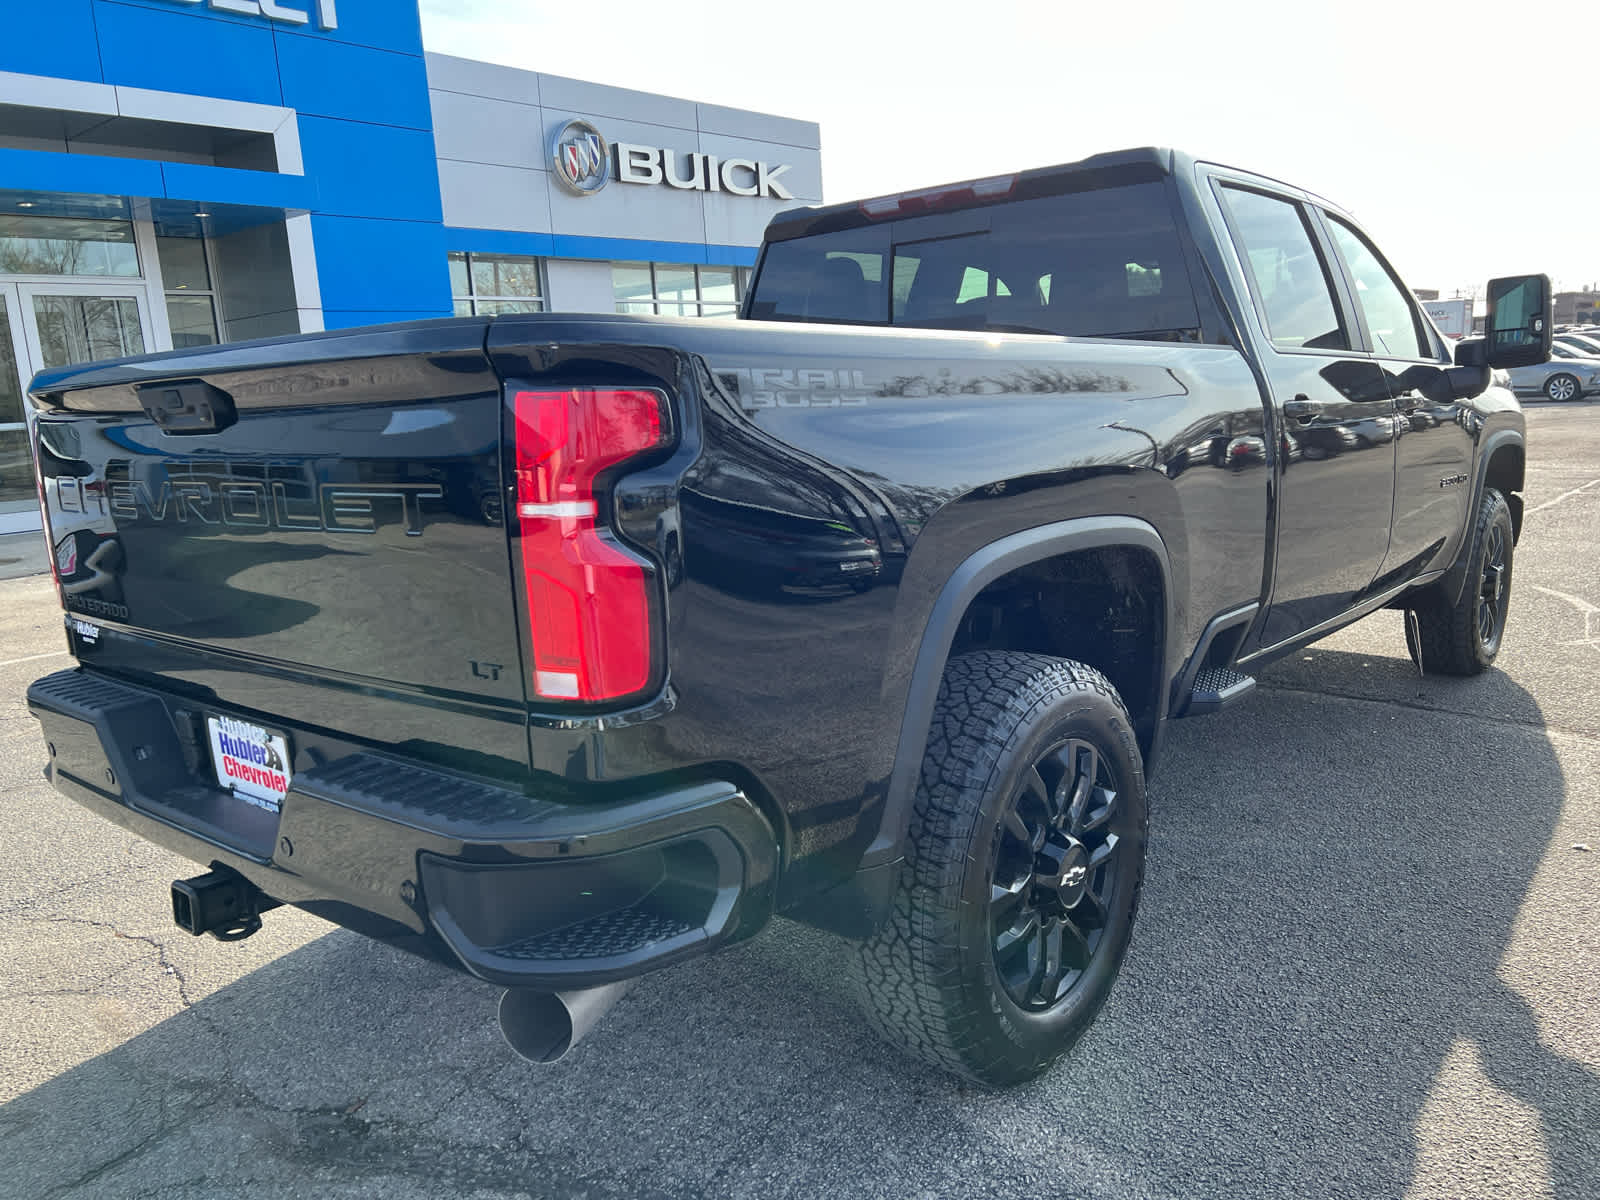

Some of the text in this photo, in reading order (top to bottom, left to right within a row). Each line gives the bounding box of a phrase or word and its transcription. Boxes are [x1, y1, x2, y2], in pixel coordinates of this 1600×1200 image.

[615, 142, 793, 200] BUICK
[711, 367, 870, 391] TRAIL
[56, 475, 443, 536] CHEVROLET
[468, 660, 504, 680] LT
[218, 731, 266, 766] Hubler
[223, 755, 288, 793] Chevrolet
